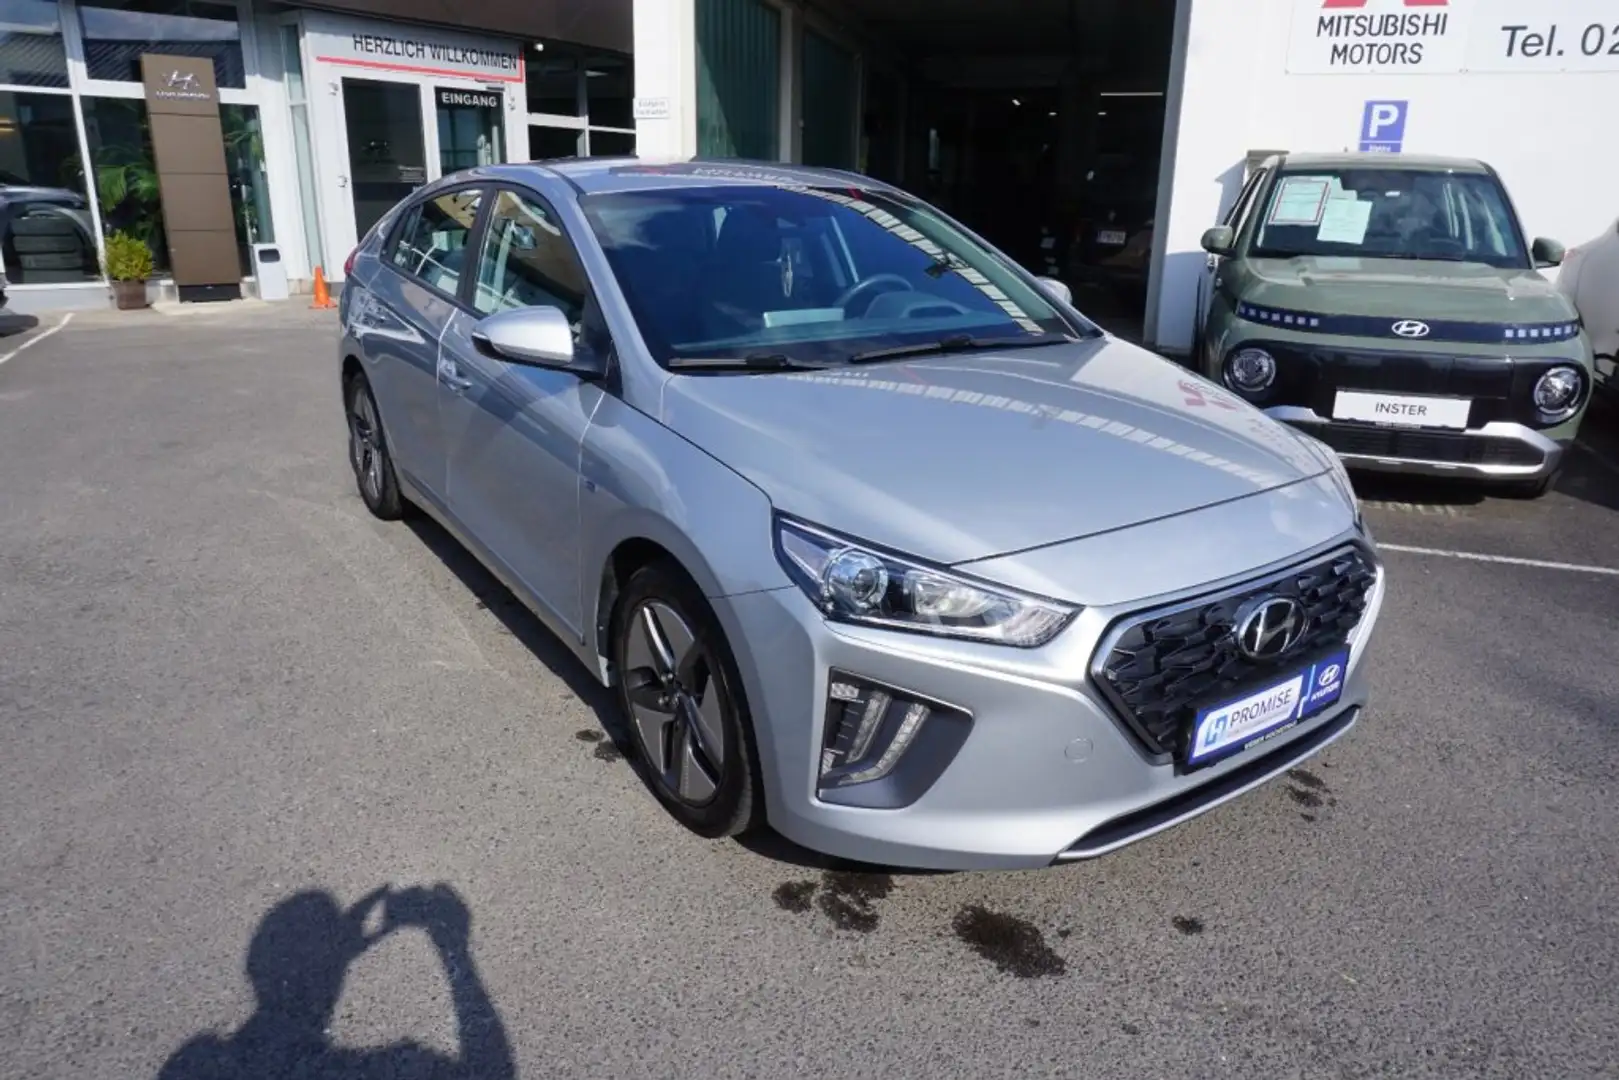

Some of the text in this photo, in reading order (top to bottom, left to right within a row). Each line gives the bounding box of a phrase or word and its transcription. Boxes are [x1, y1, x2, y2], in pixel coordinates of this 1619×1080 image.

[1317, 13, 1448, 37] MITSUBISHI
[352, 33, 517, 70] HERZLICH WILLKOMMEN
[1330, 43, 1424, 65] MOTORS
[1501, 24, 1564, 57] Tel.
[441, 92, 497, 107] EINGANG
[1369, 104, 1399, 137] P
[1375, 402, 1427, 416] INSTER
[1230, 688, 1292, 728] PROMISE
